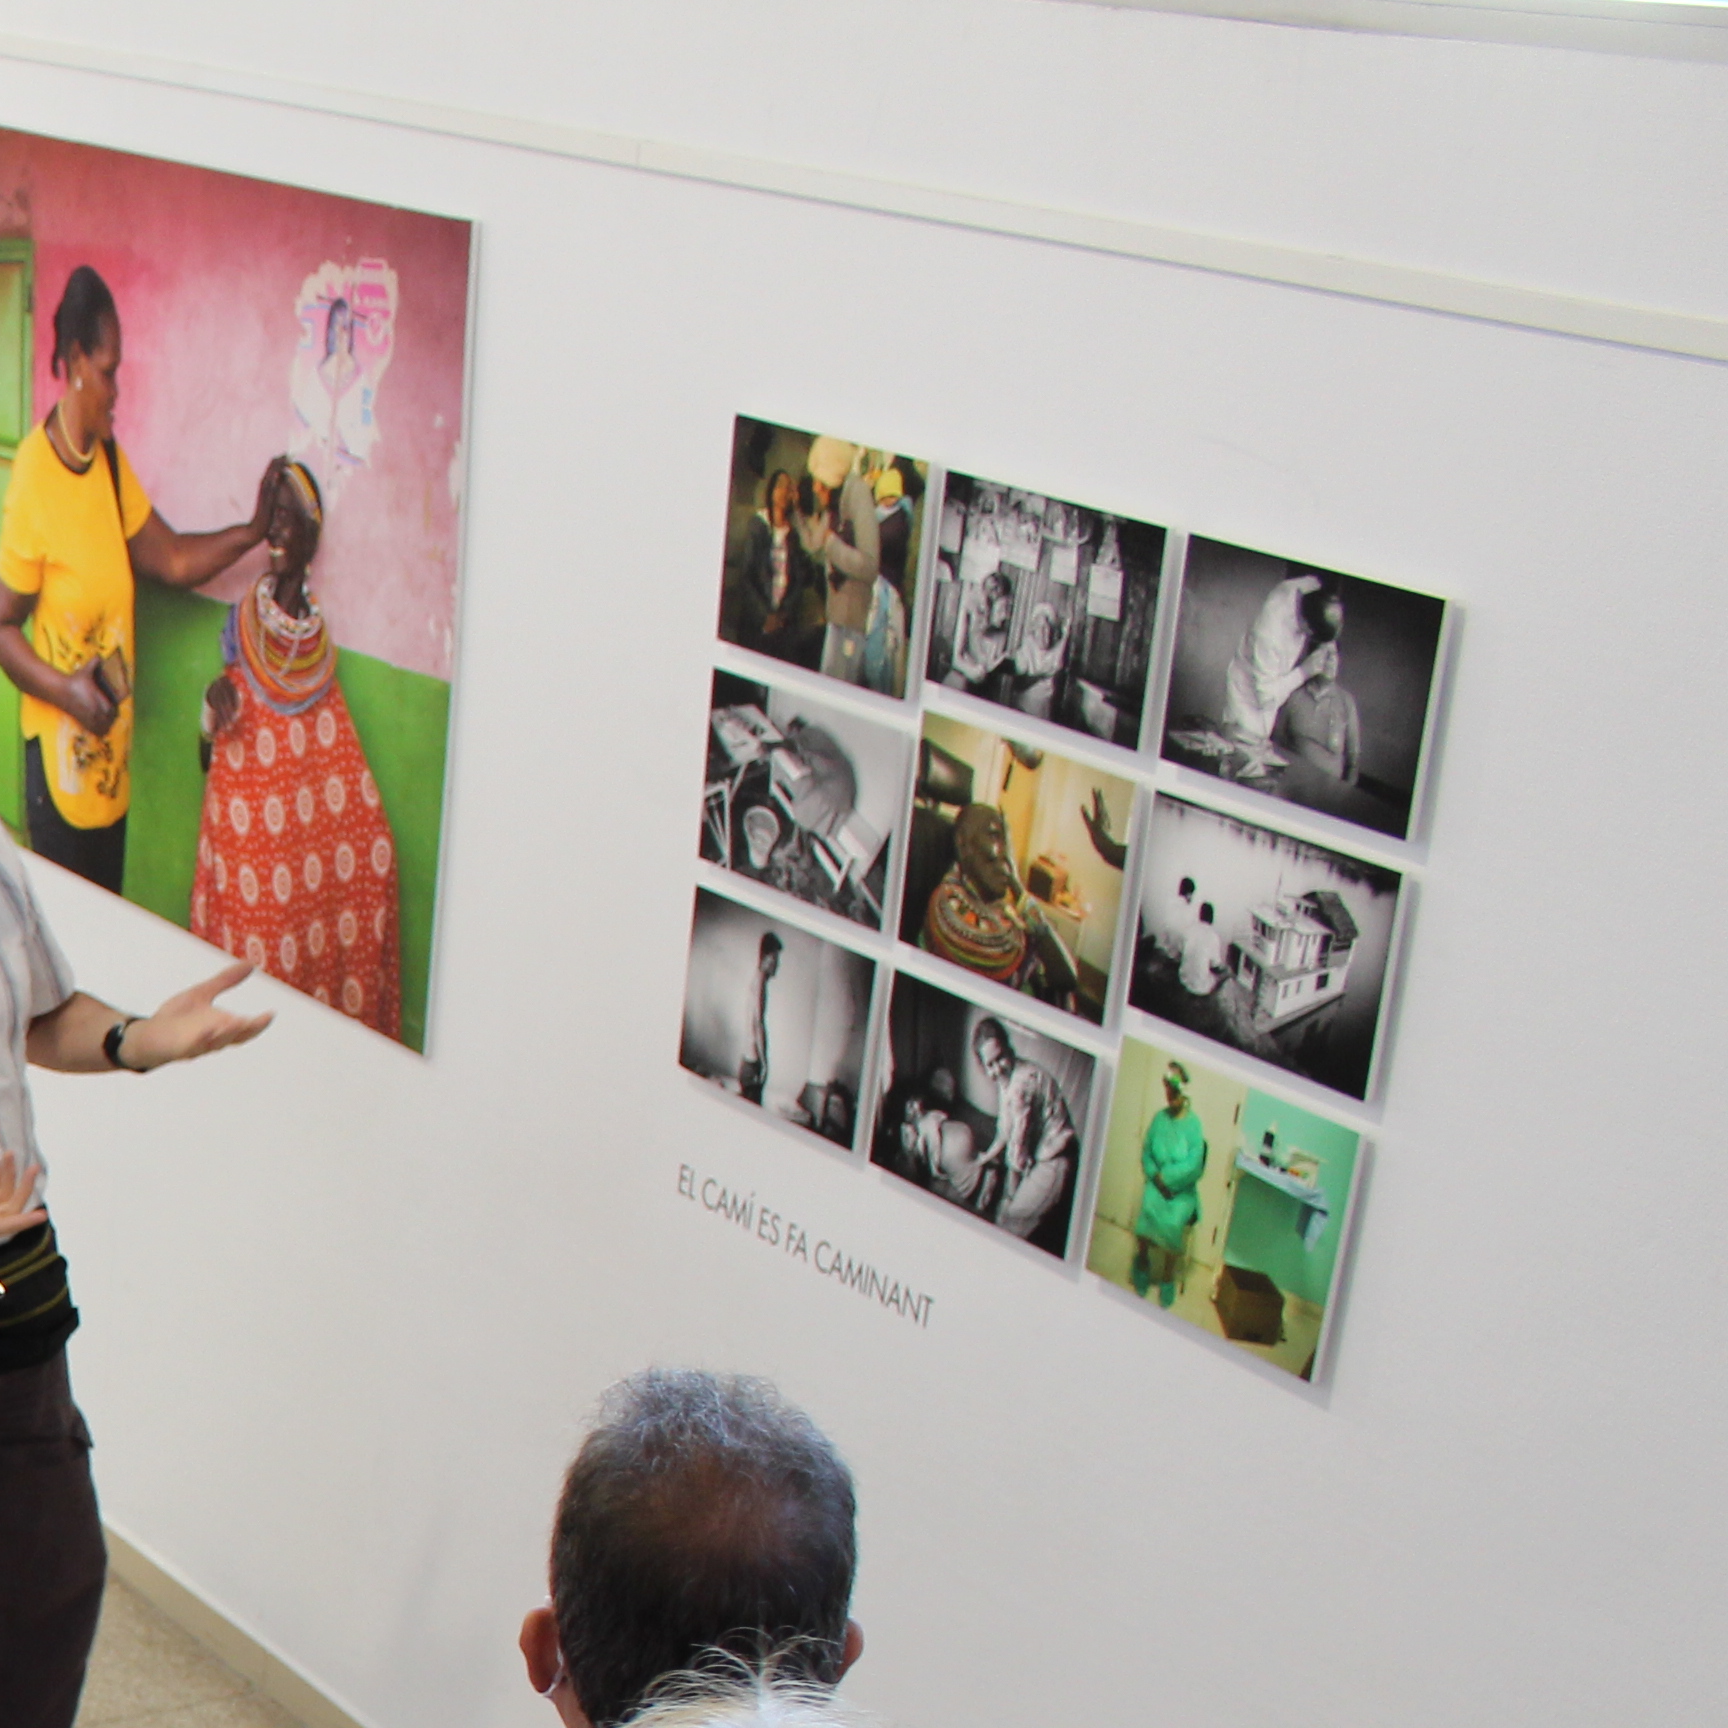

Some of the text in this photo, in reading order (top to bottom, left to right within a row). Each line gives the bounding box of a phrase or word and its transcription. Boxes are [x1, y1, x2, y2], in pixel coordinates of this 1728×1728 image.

[677, 1163, 936, 1329] EL CAMÍ ES FA CAMINANT
